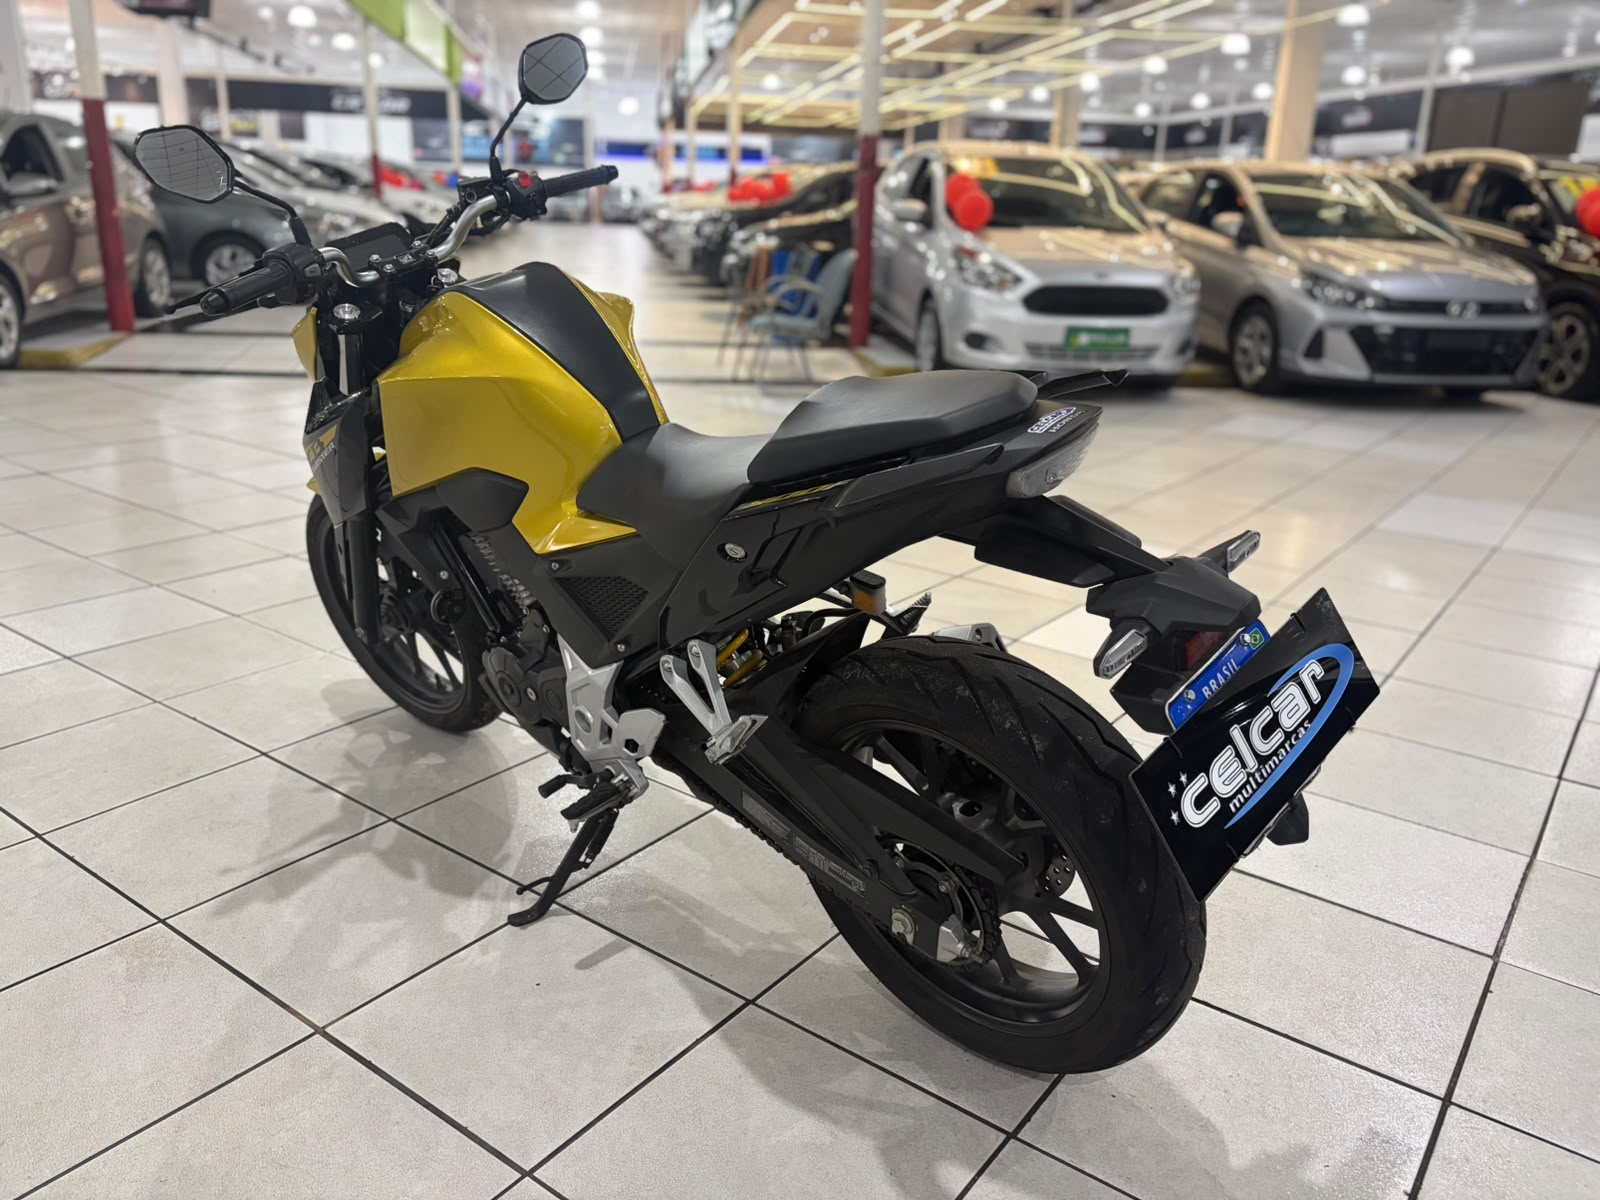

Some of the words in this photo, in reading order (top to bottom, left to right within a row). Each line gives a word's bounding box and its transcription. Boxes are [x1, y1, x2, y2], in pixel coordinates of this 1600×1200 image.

[1202, 658, 1240, 699] BRASIL
[1180, 660, 1325, 828] celcar
[1228, 719, 1311, 813] multimarcas
